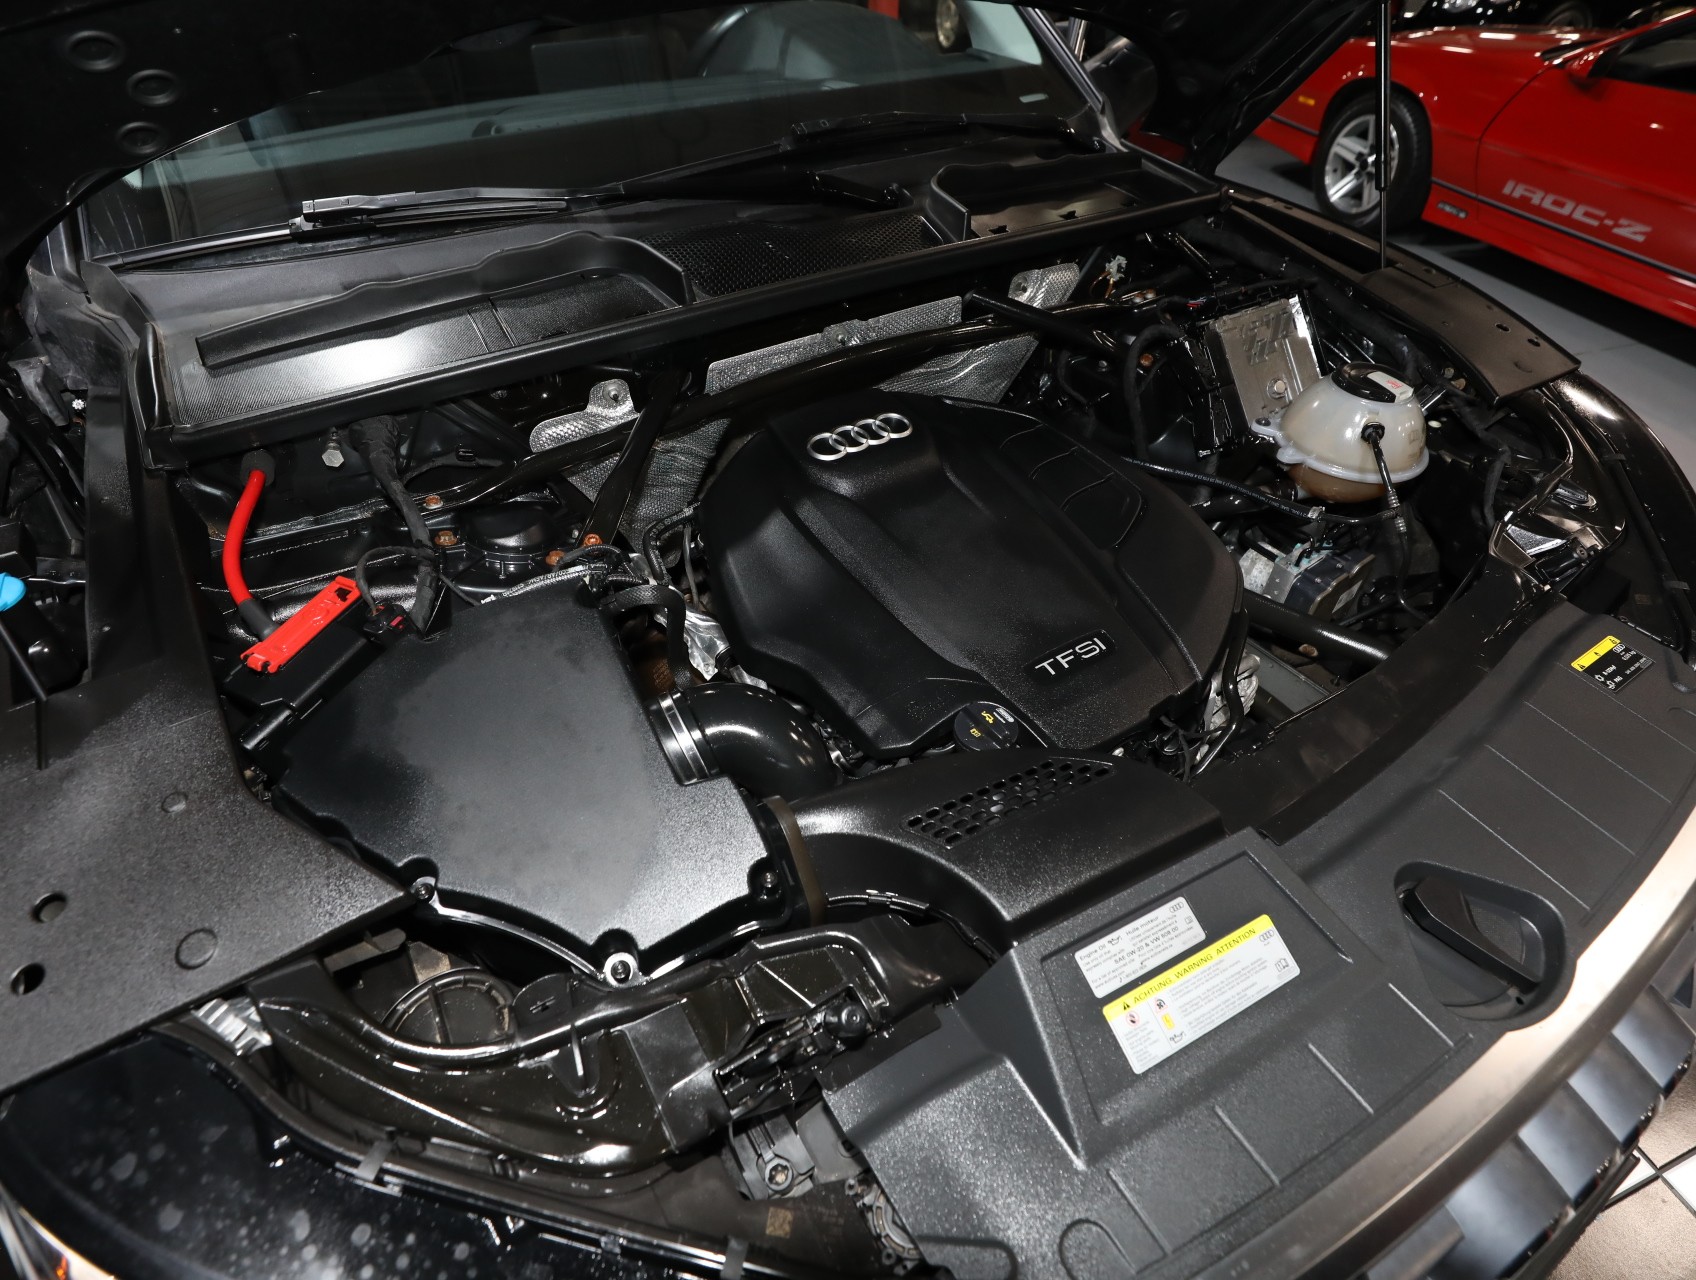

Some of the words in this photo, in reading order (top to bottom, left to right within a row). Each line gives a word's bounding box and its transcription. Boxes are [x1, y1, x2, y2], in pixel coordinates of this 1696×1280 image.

[1502, 179, 1653, 243] IROC-Z
[1035, 637, 1107, 676] TFSI
[1126, 926, 1140, 936] Huile
[1140, 916, 1159, 929] moteur
[1079, 948, 1098, 961] Engine
[1098, 943, 1107, 951] Oil
[1114, 955, 1126, 964] SAE
[1150, 936, 1161, 944] VW
[1133, 977, 1172, 1004] ACHTUNG
[1174, 953, 1213, 979] WARNING
[1216, 928, 1256, 955] ATTENTION
